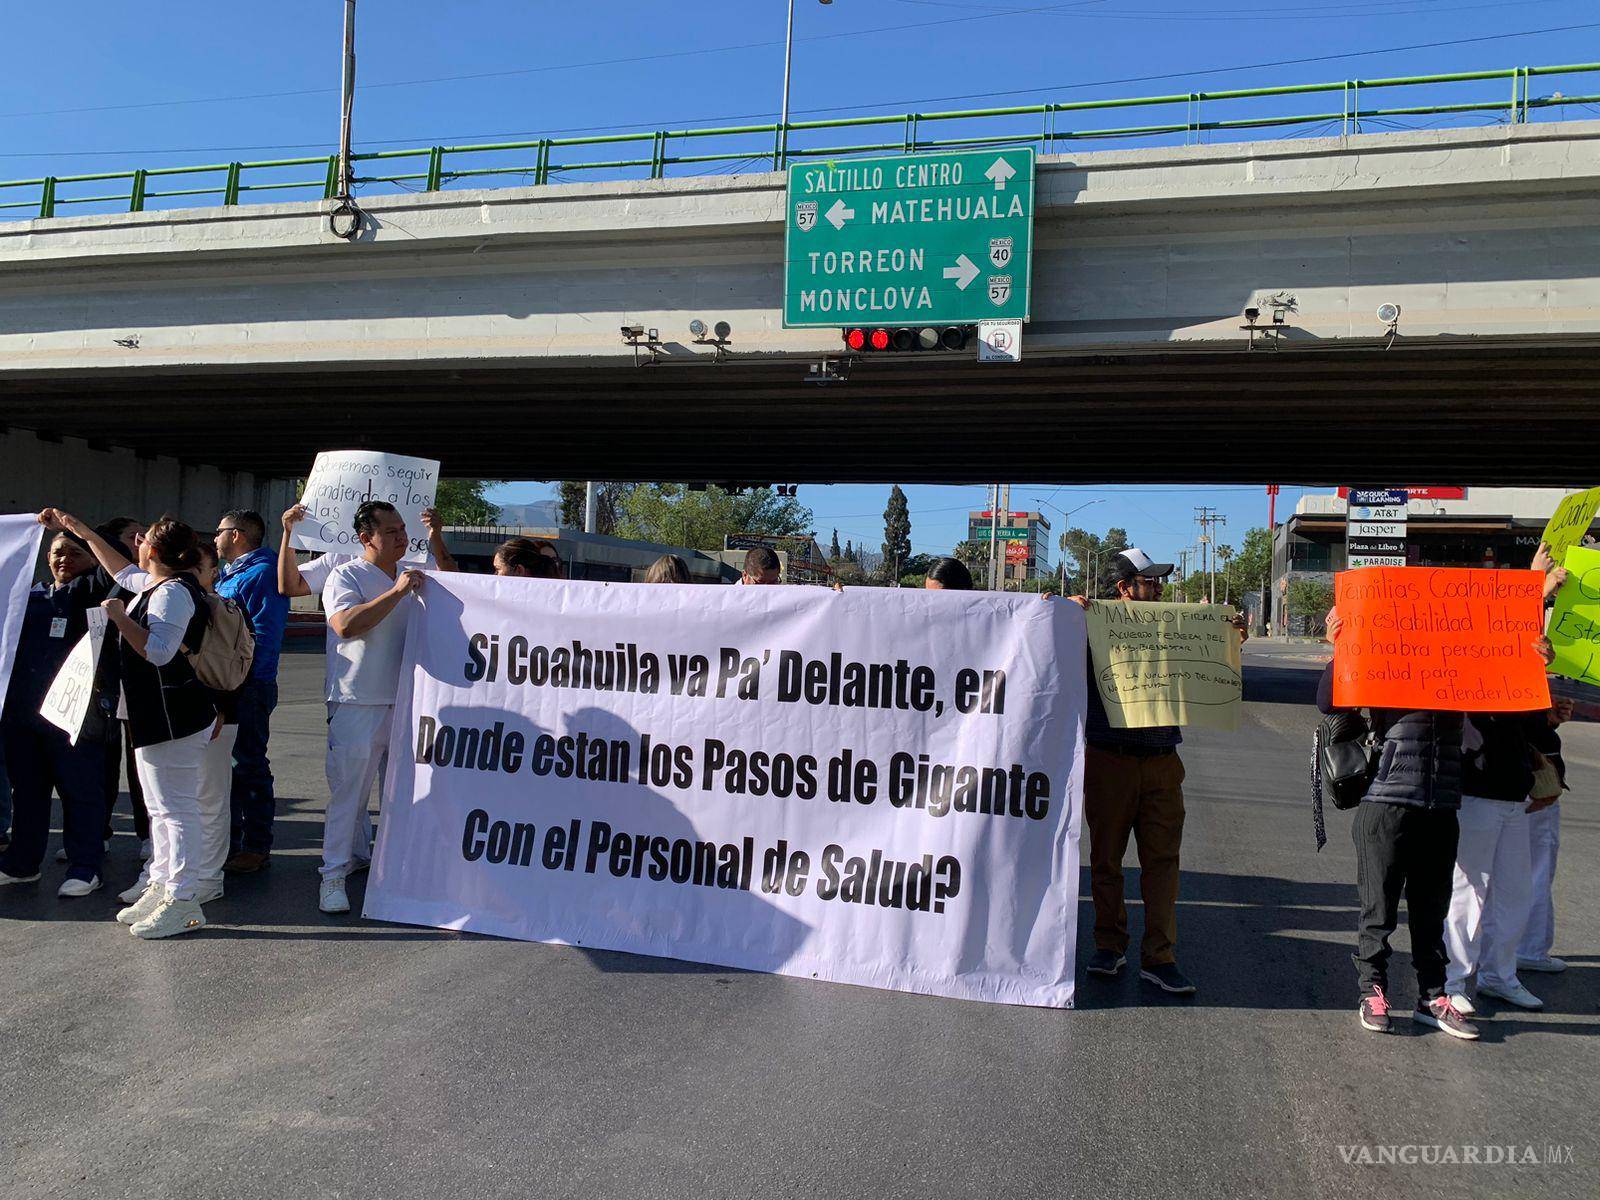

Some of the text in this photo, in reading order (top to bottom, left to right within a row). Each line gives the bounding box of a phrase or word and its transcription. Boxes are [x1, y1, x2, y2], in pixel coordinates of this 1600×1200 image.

[804, 162, 963, 193] SALTILLO CENTRO
[799, 213, 815, 225] 57
[872, 194, 1024, 224] MATEHUALA
[808, 248, 924, 274] TORREON
[993, 249, 1009, 261] 40
[800, 286, 933, 312] MONCLOVA
[991, 287, 1008, 299] 57
[387, 465, 432, 487] seguir
[388, 493, 398, 503] a
[406, 486, 430, 507] los
[1373, 509, 1398, 518] AT&T
[1359, 524, 1396, 536] jasper
[1363, 558, 1403, 566] PARADISE
[1429, 569, 1543, 600] Coahuilenses
[1181, 612, 1216, 621] FIRMA
[1373, 601, 1473, 632] estabilidad
[1486, 604, 1543, 635] laboral
[1207, 633, 1226, 642] DEL
[1338, 629, 1521, 668] no habra personal
[464, 632, 500, 683] Si
[507, 635, 660, 695] Coahuila
[668, 654, 709, 697] va
[777, 650, 944, 718] Delante,
[955, 667, 1006, 715] en
[1367, 660, 1411, 681] salud
[1420, 668, 1458, 690] para
[415, 715, 1050, 820] Donde estan los Pasos de Gigante
[461, 808, 962, 914] Con el Personal de Salud?
